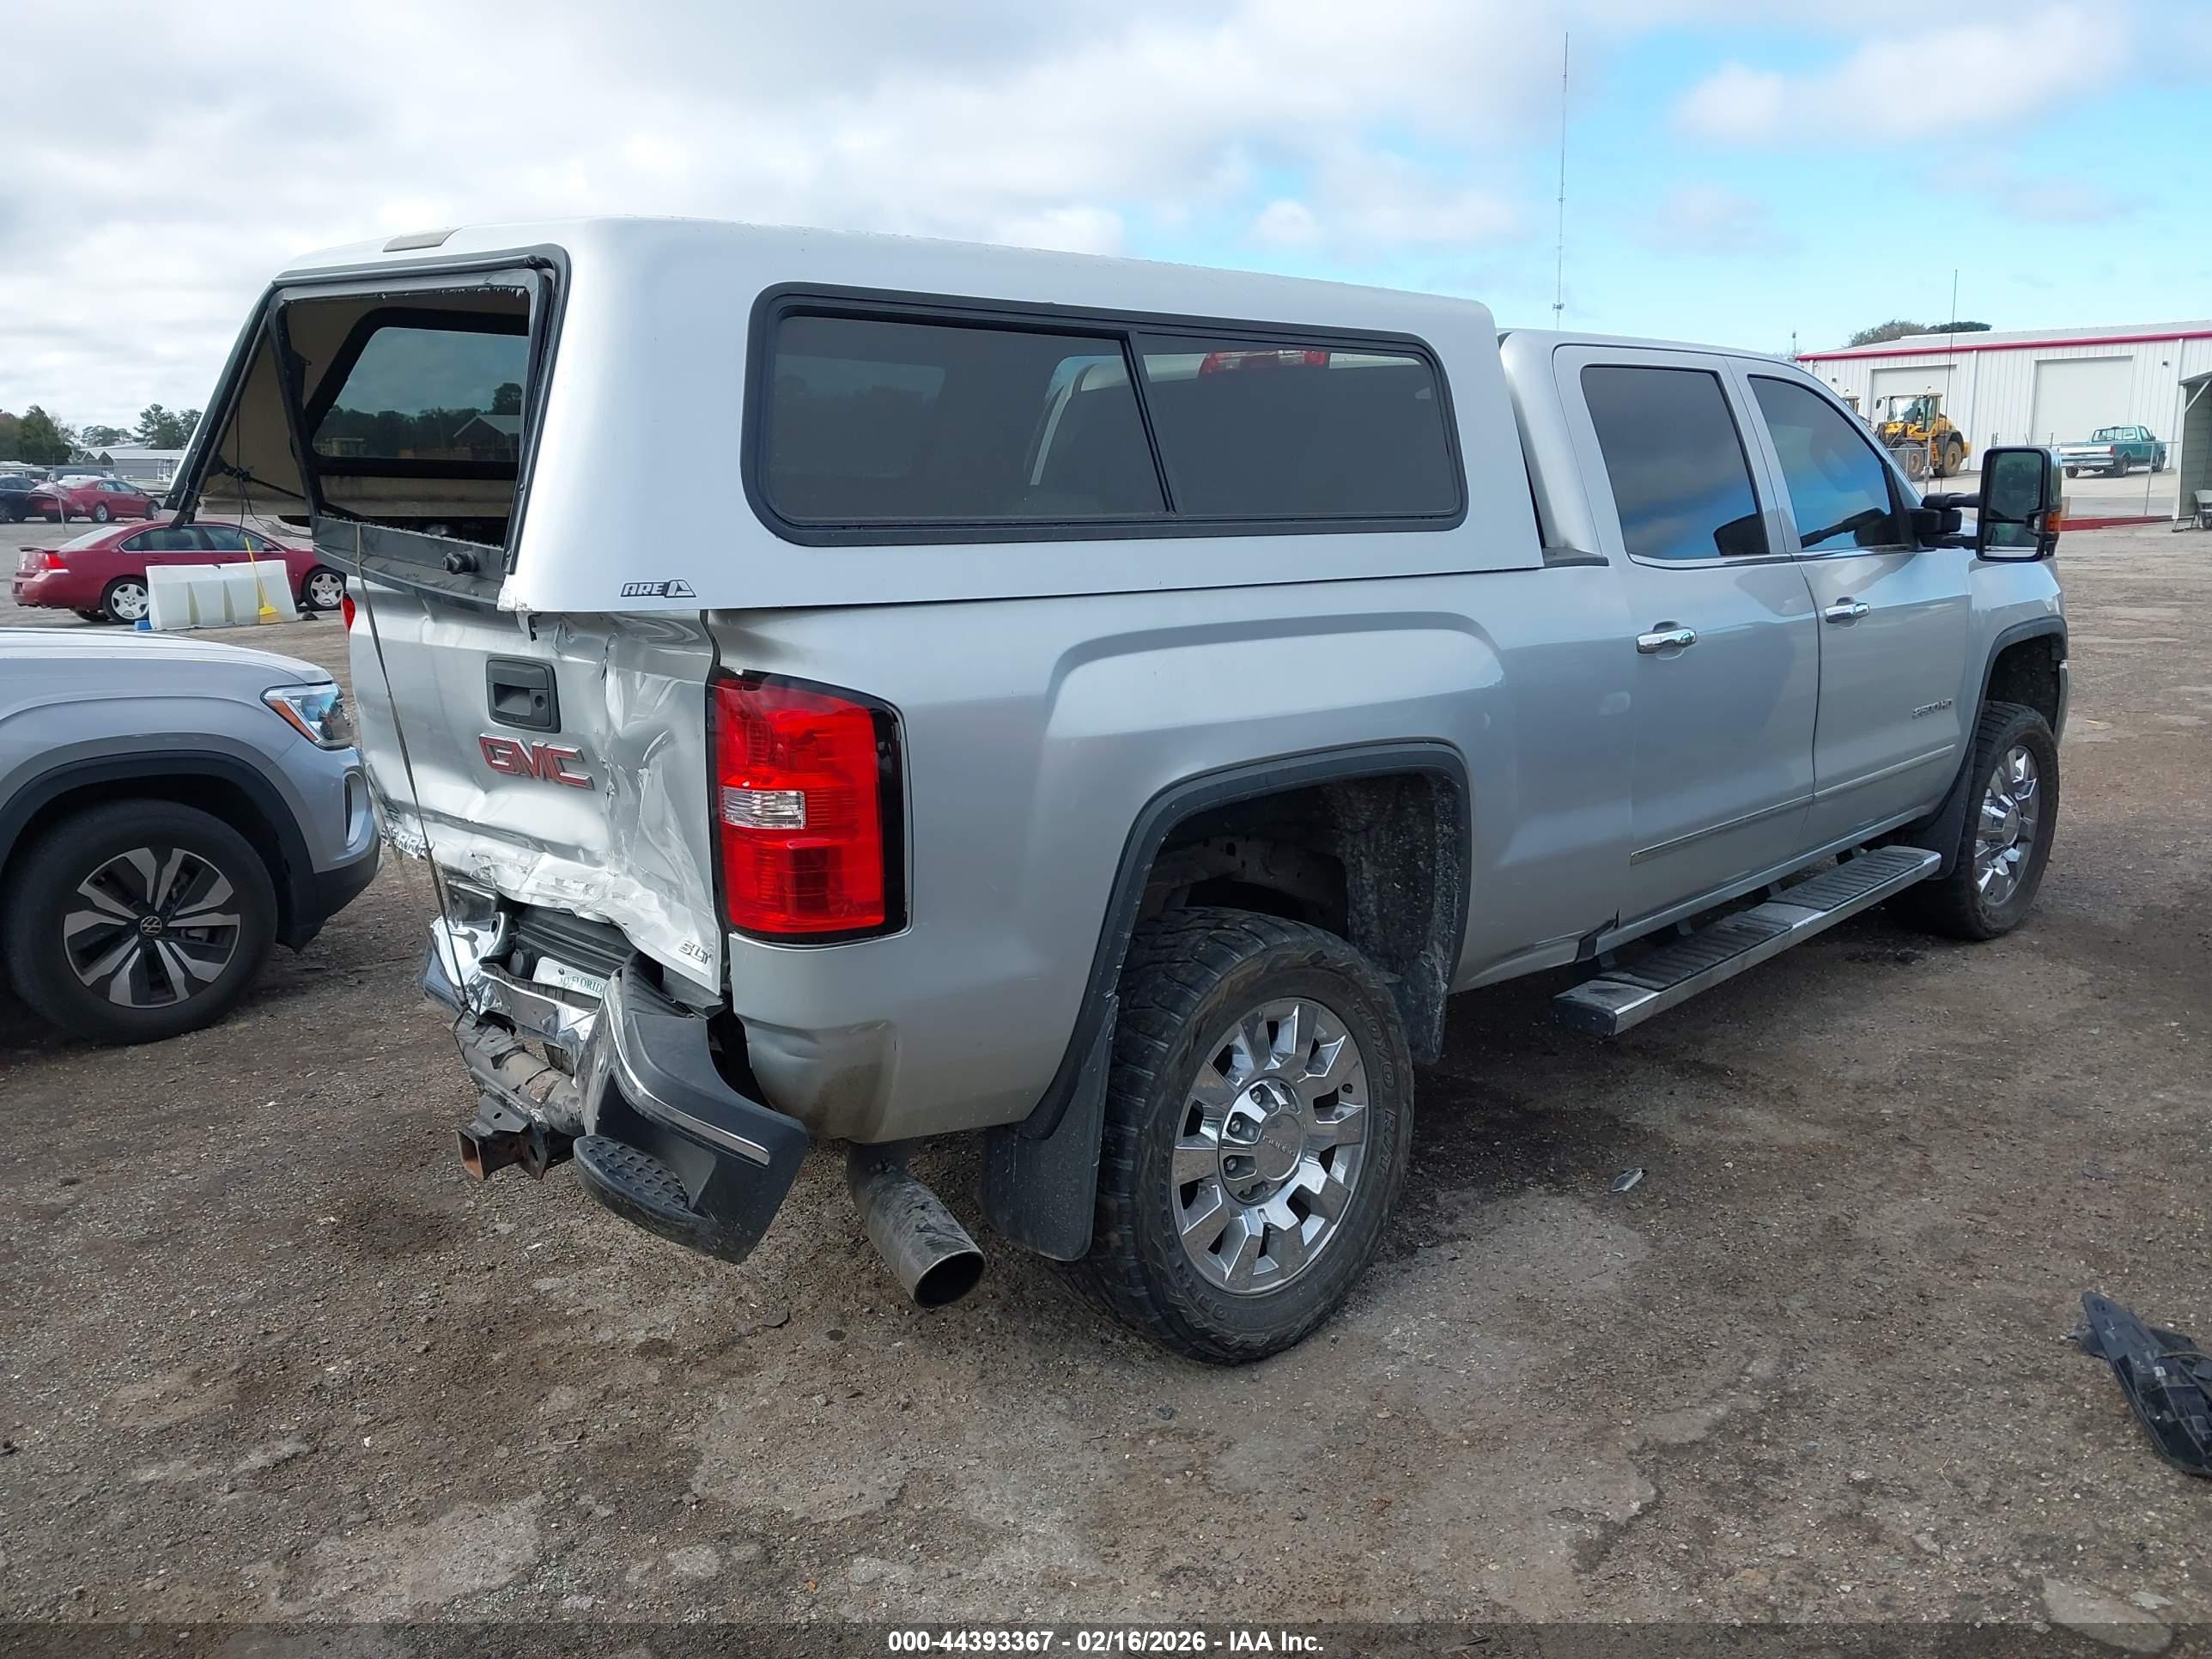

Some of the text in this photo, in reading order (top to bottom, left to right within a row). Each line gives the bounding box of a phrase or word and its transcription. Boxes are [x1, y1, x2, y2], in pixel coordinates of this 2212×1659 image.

[479, 732, 595, 791] GMC
[678, 940, 708, 964] SLT
[1353, 1000, 1395, 1090] TOYO
